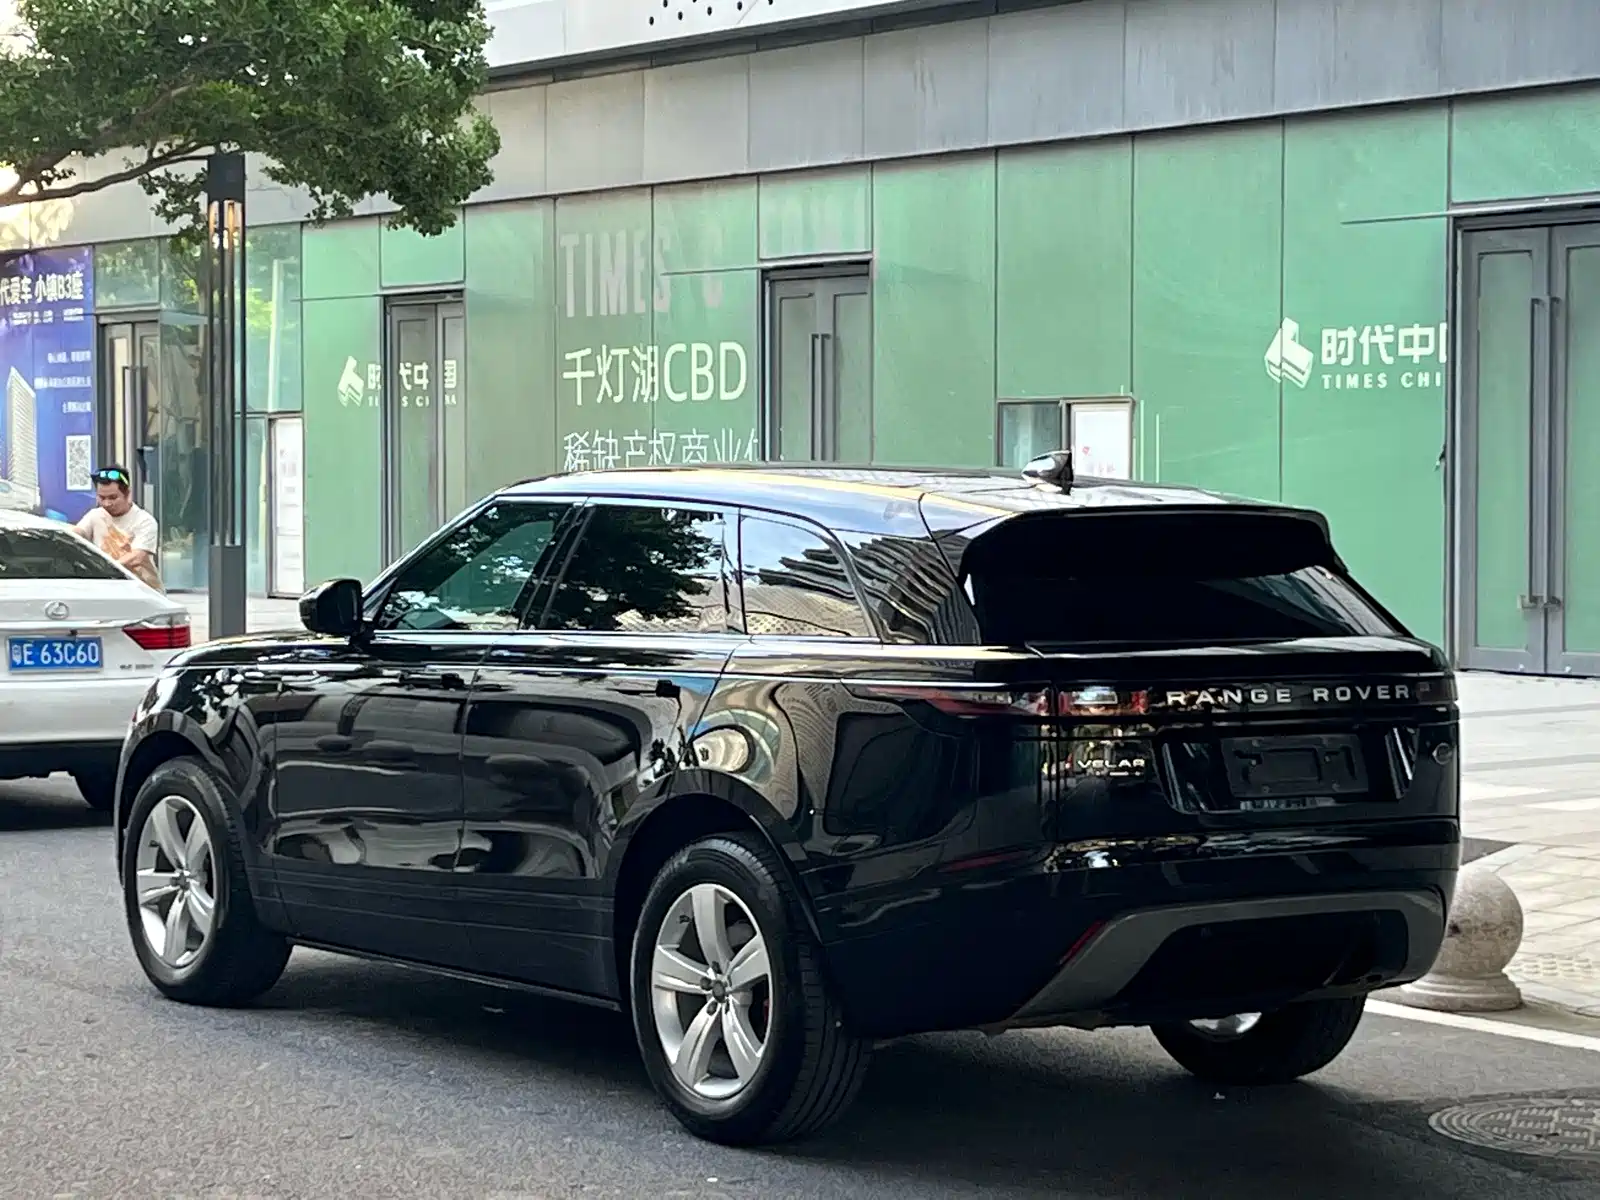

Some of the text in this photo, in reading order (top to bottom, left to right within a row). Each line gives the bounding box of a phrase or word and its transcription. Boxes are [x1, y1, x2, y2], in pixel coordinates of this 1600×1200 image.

[560, 228, 671, 318] TIMES
[1321, 322, 1447, 366] 时代中
[563, 342, 747, 405] 千灯湖CBD
[1321, 372, 1388, 389] TIMES
[1166, 684, 1410, 706] RANGE ROVER
[1077, 758, 1145, 769] VELAR
